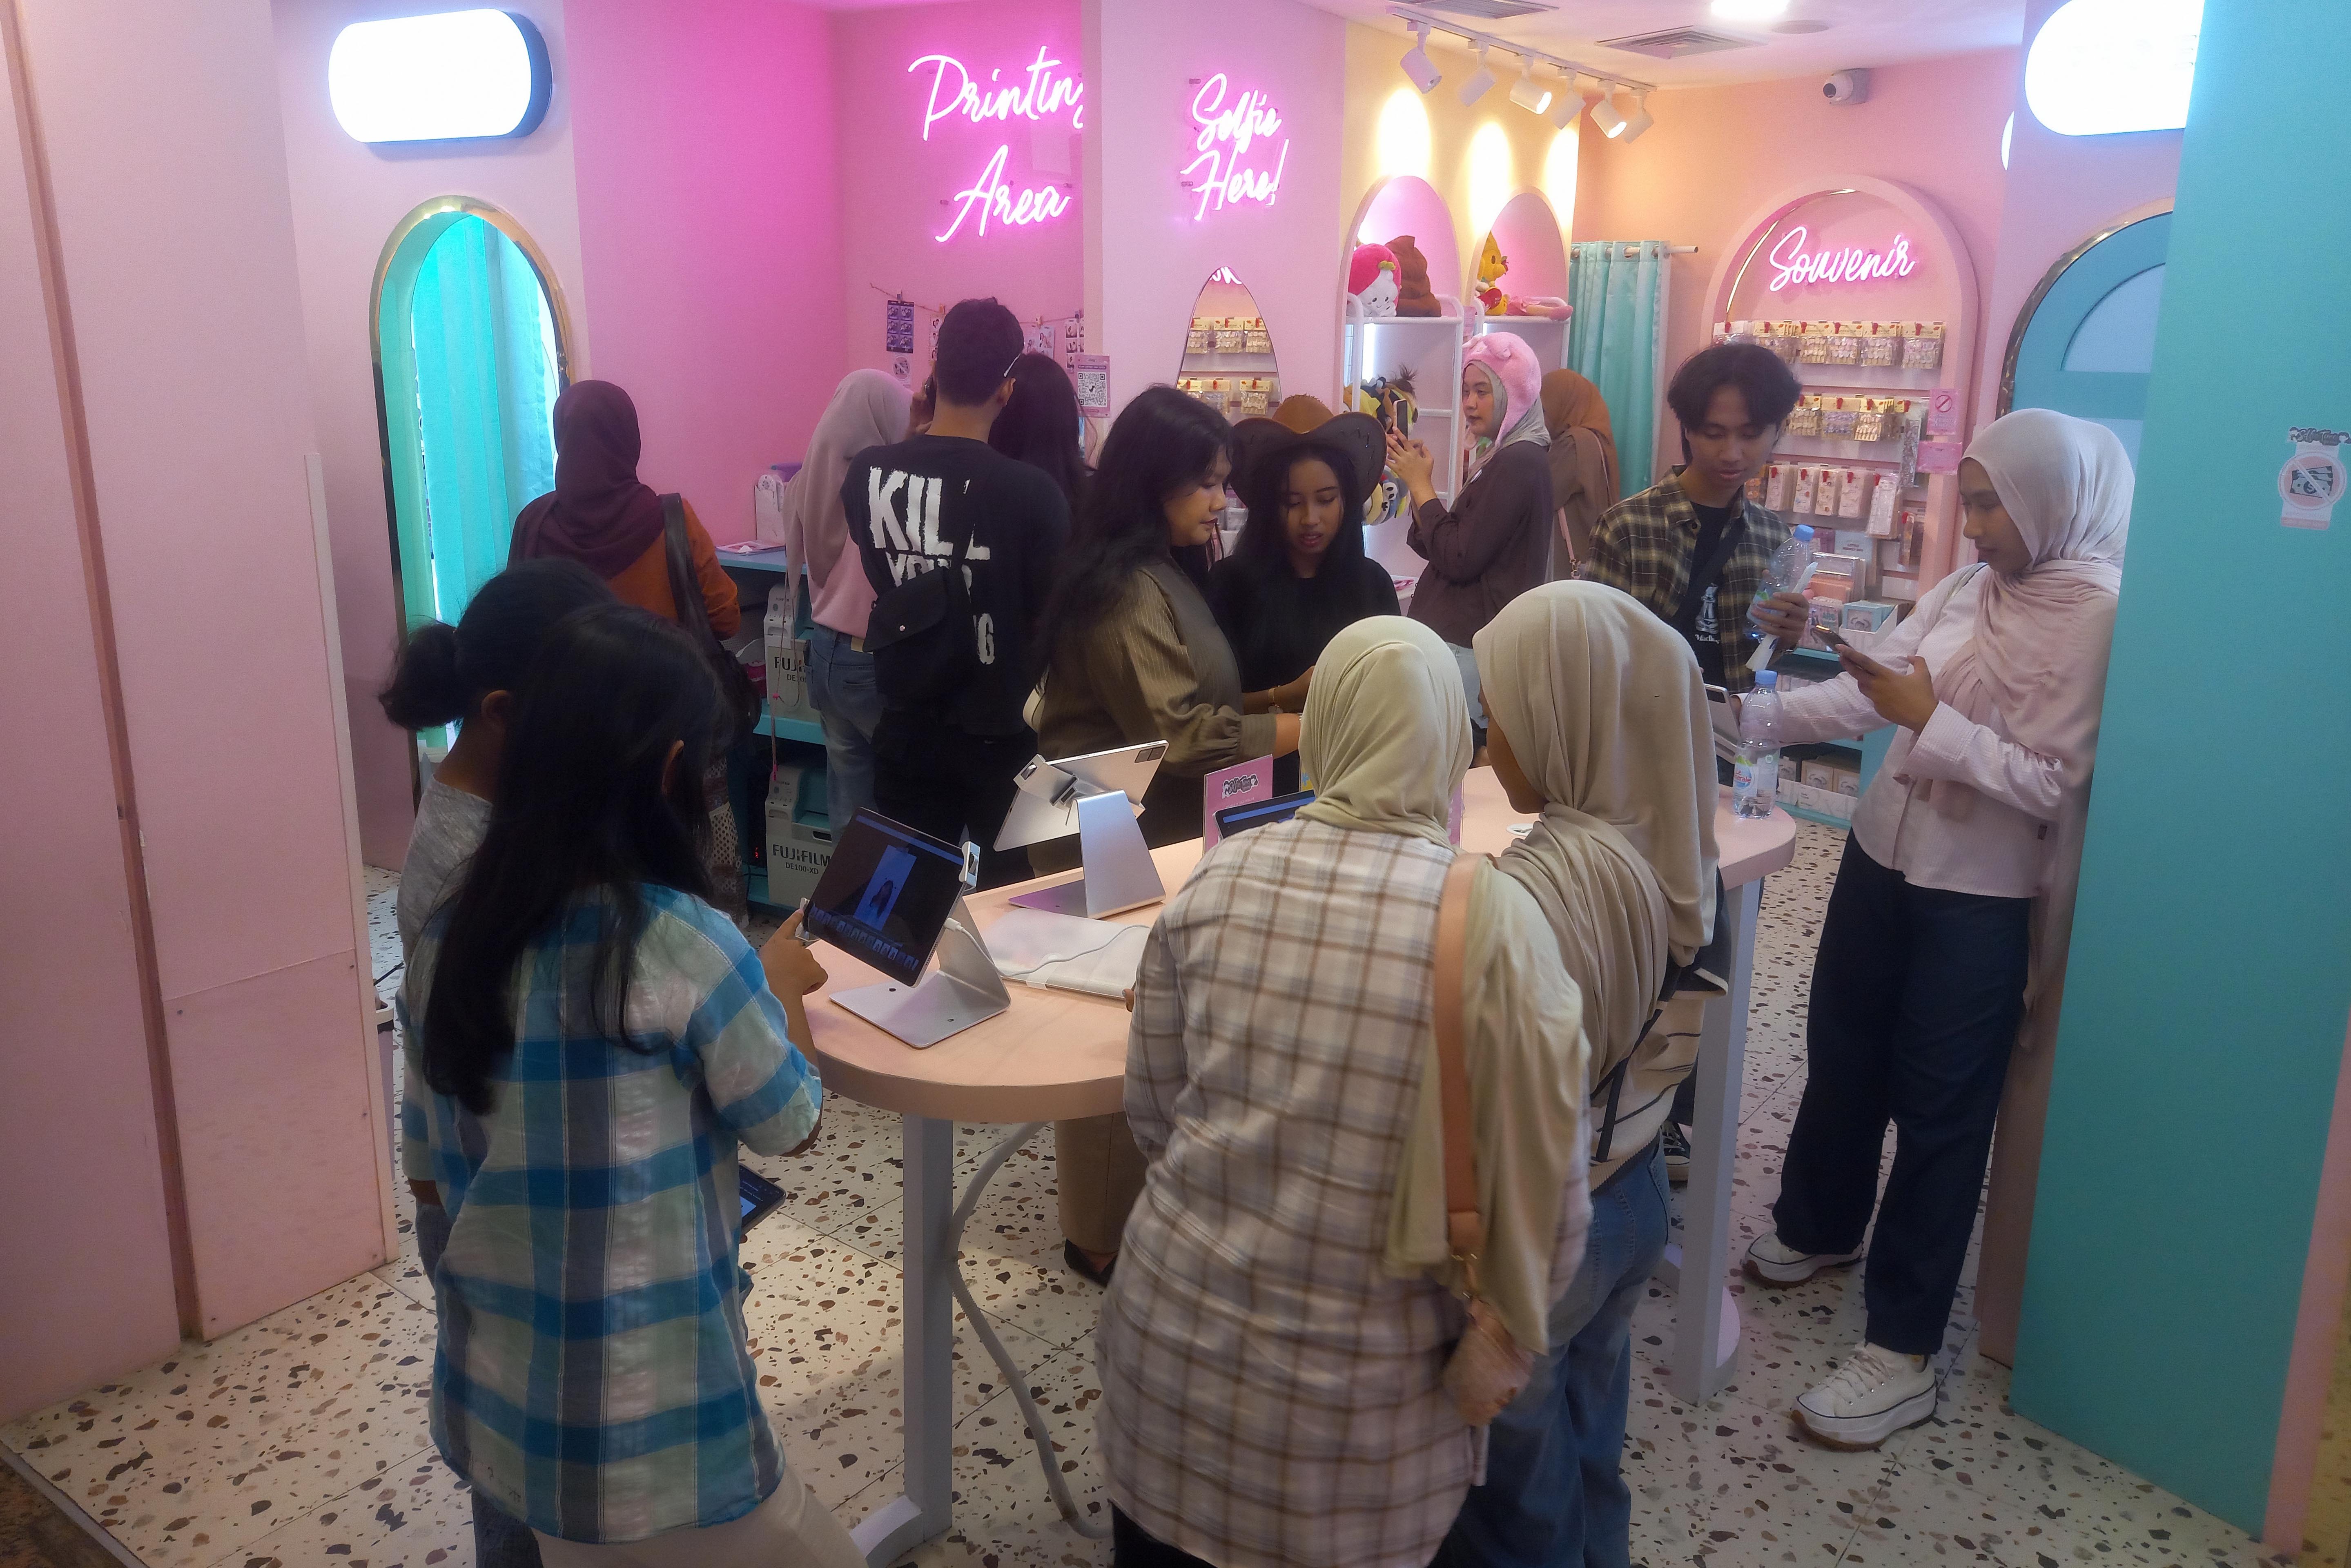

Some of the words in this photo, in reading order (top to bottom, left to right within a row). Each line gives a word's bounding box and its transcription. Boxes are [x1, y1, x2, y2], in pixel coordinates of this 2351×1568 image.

[1192, 73, 1282, 154] Selfie
[935, 145, 1071, 243] Area
[1180, 138, 1289, 221] Here!
[1769, 226, 1915, 292] Souvenir
[785, 862, 819, 875] DE100-XD
